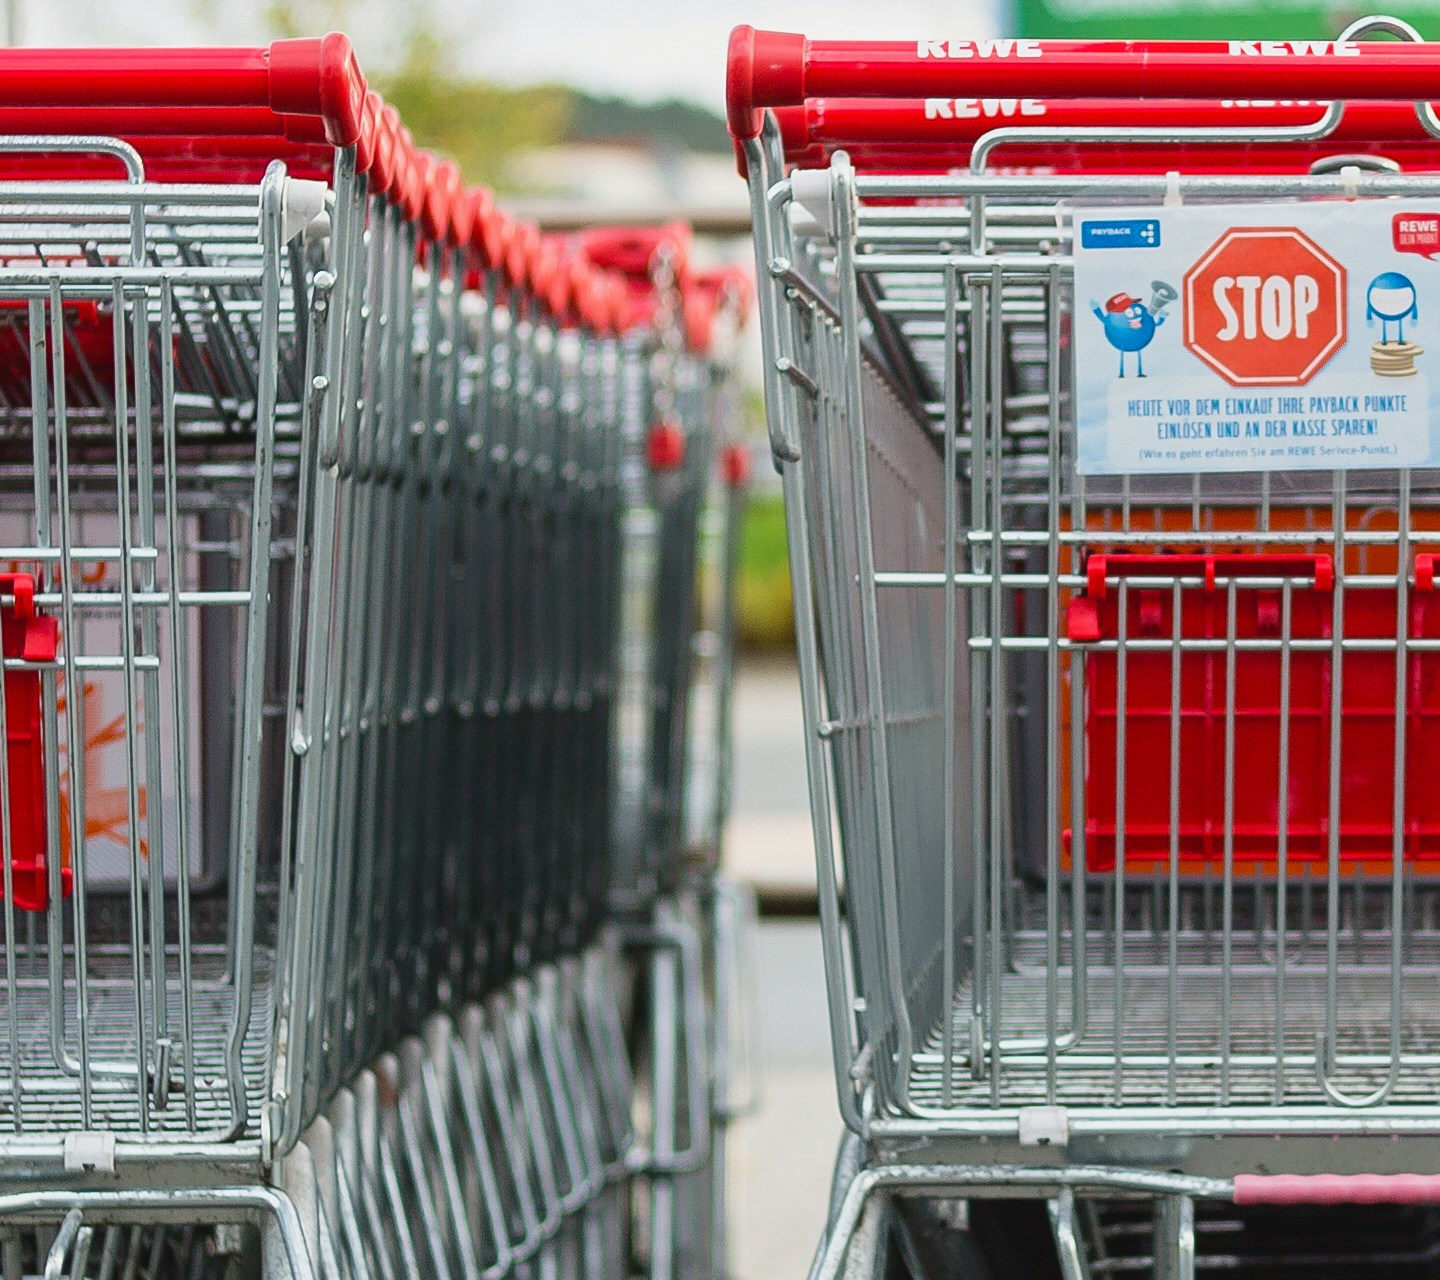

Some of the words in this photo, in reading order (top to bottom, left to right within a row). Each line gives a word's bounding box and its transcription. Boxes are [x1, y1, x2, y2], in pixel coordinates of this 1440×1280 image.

[1091, 227, 1132, 236] PAYBACK
[1399, 220, 1439, 232] REWE
[1212, 274, 1320, 341] STOP
[1128, 398, 1164, 417] HEUTE
[1168, 398, 1191, 417] VOR
[1195, 398, 1220, 416] DEM
[1225, 396, 1274, 416] EINKAUF
[1278, 396, 1305, 415] IHRE
[1310, 395, 1360, 414] PAYBACK
[1364, 394, 1408, 413] PUNKTE
[1157, 418, 1211, 440] EINLÖSEN
[1217, 419, 1240, 438] UND
[1244, 419, 1261, 438] AN
[1265, 419, 1288, 438] DER
[1292, 418, 1327, 437] KASSE
[1331, 417, 1379, 436] SPAREN!
[1139, 448, 1163, 460] (Wie
[1165, 450, 1176, 458] es
[1179, 449, 1202, 460] geht
[1205, 447, 1248, 458] erfahren
[1250, 447, 1267, 457] Sie
[1269, 448, 1285, 456] am
[1288, 446, 1316, 456] REWE
